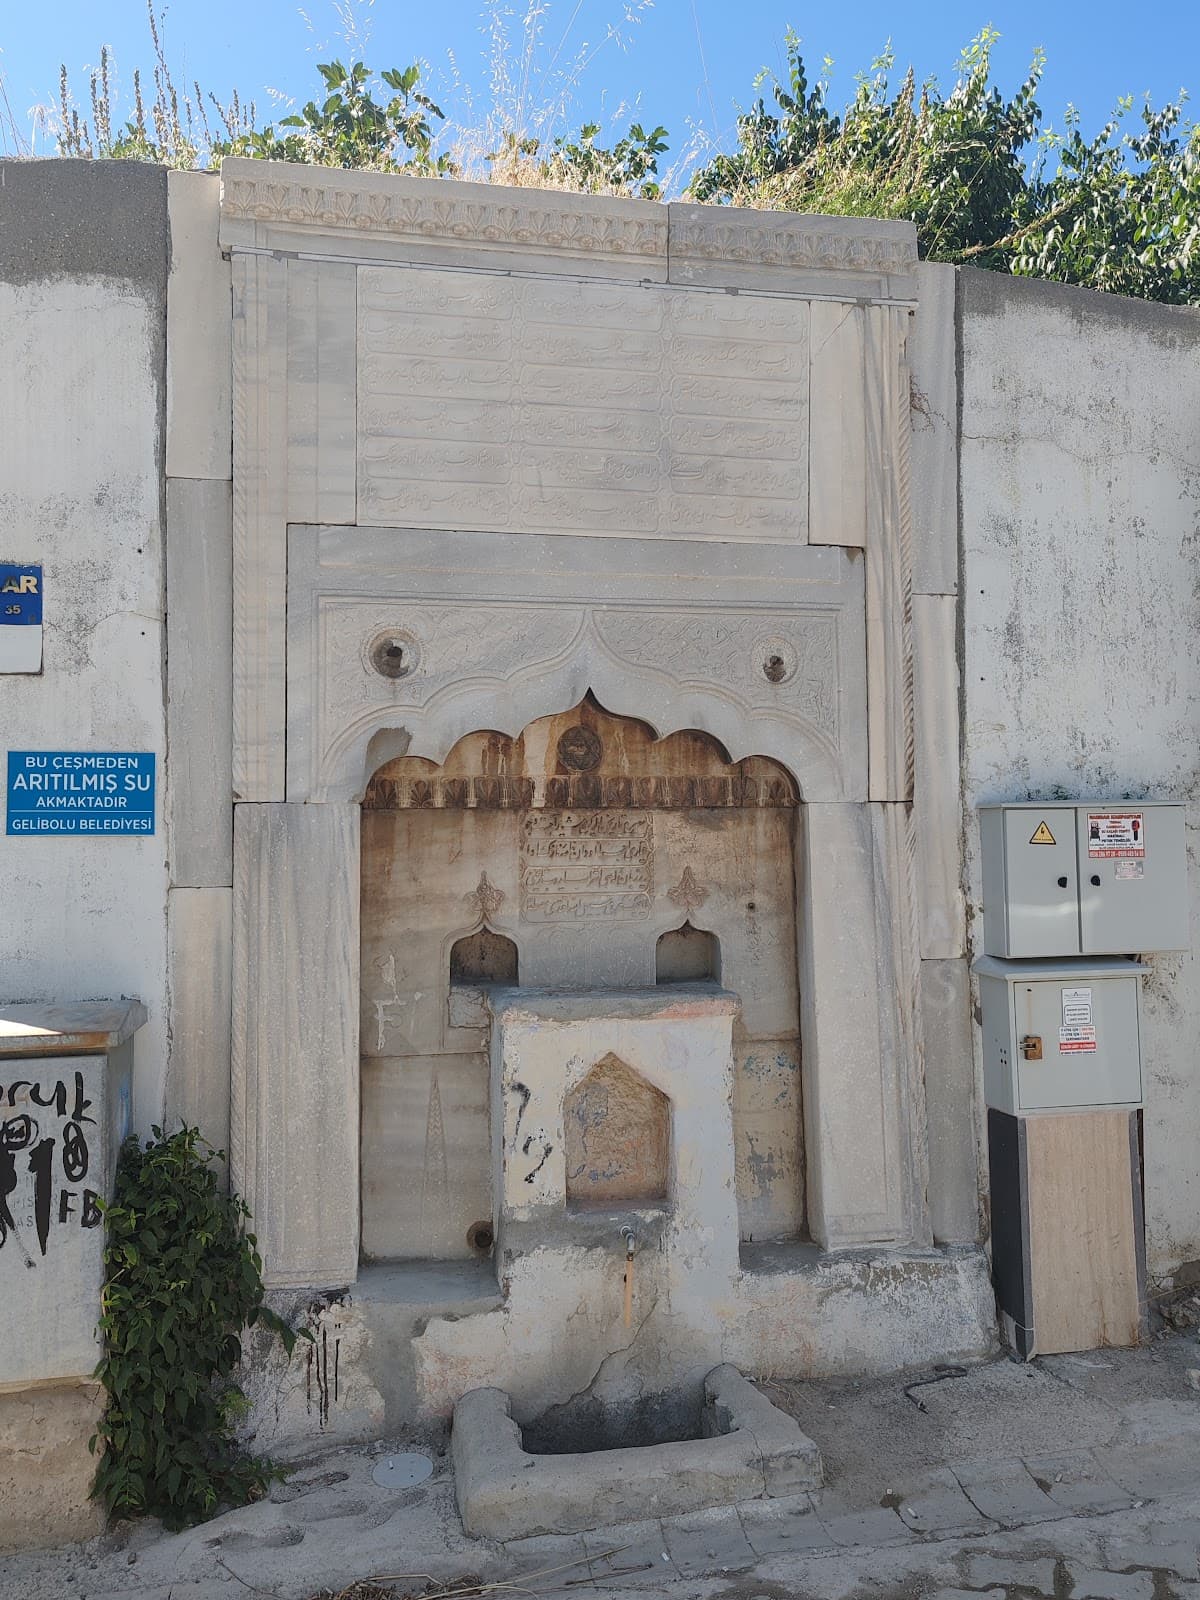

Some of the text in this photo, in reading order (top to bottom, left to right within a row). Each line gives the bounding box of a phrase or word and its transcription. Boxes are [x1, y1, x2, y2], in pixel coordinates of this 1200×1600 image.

[5, 604, 21, 615] 35
[25, 757, 139, 770] BU ÇEŞMEDEN
[13, 773, 151, 793] ARITILMIŞ SU
[36, 796, 128, 809] AKMAKTADIR
[12, 817, 152, 831] GELİBOLU BELEDİYESİ
